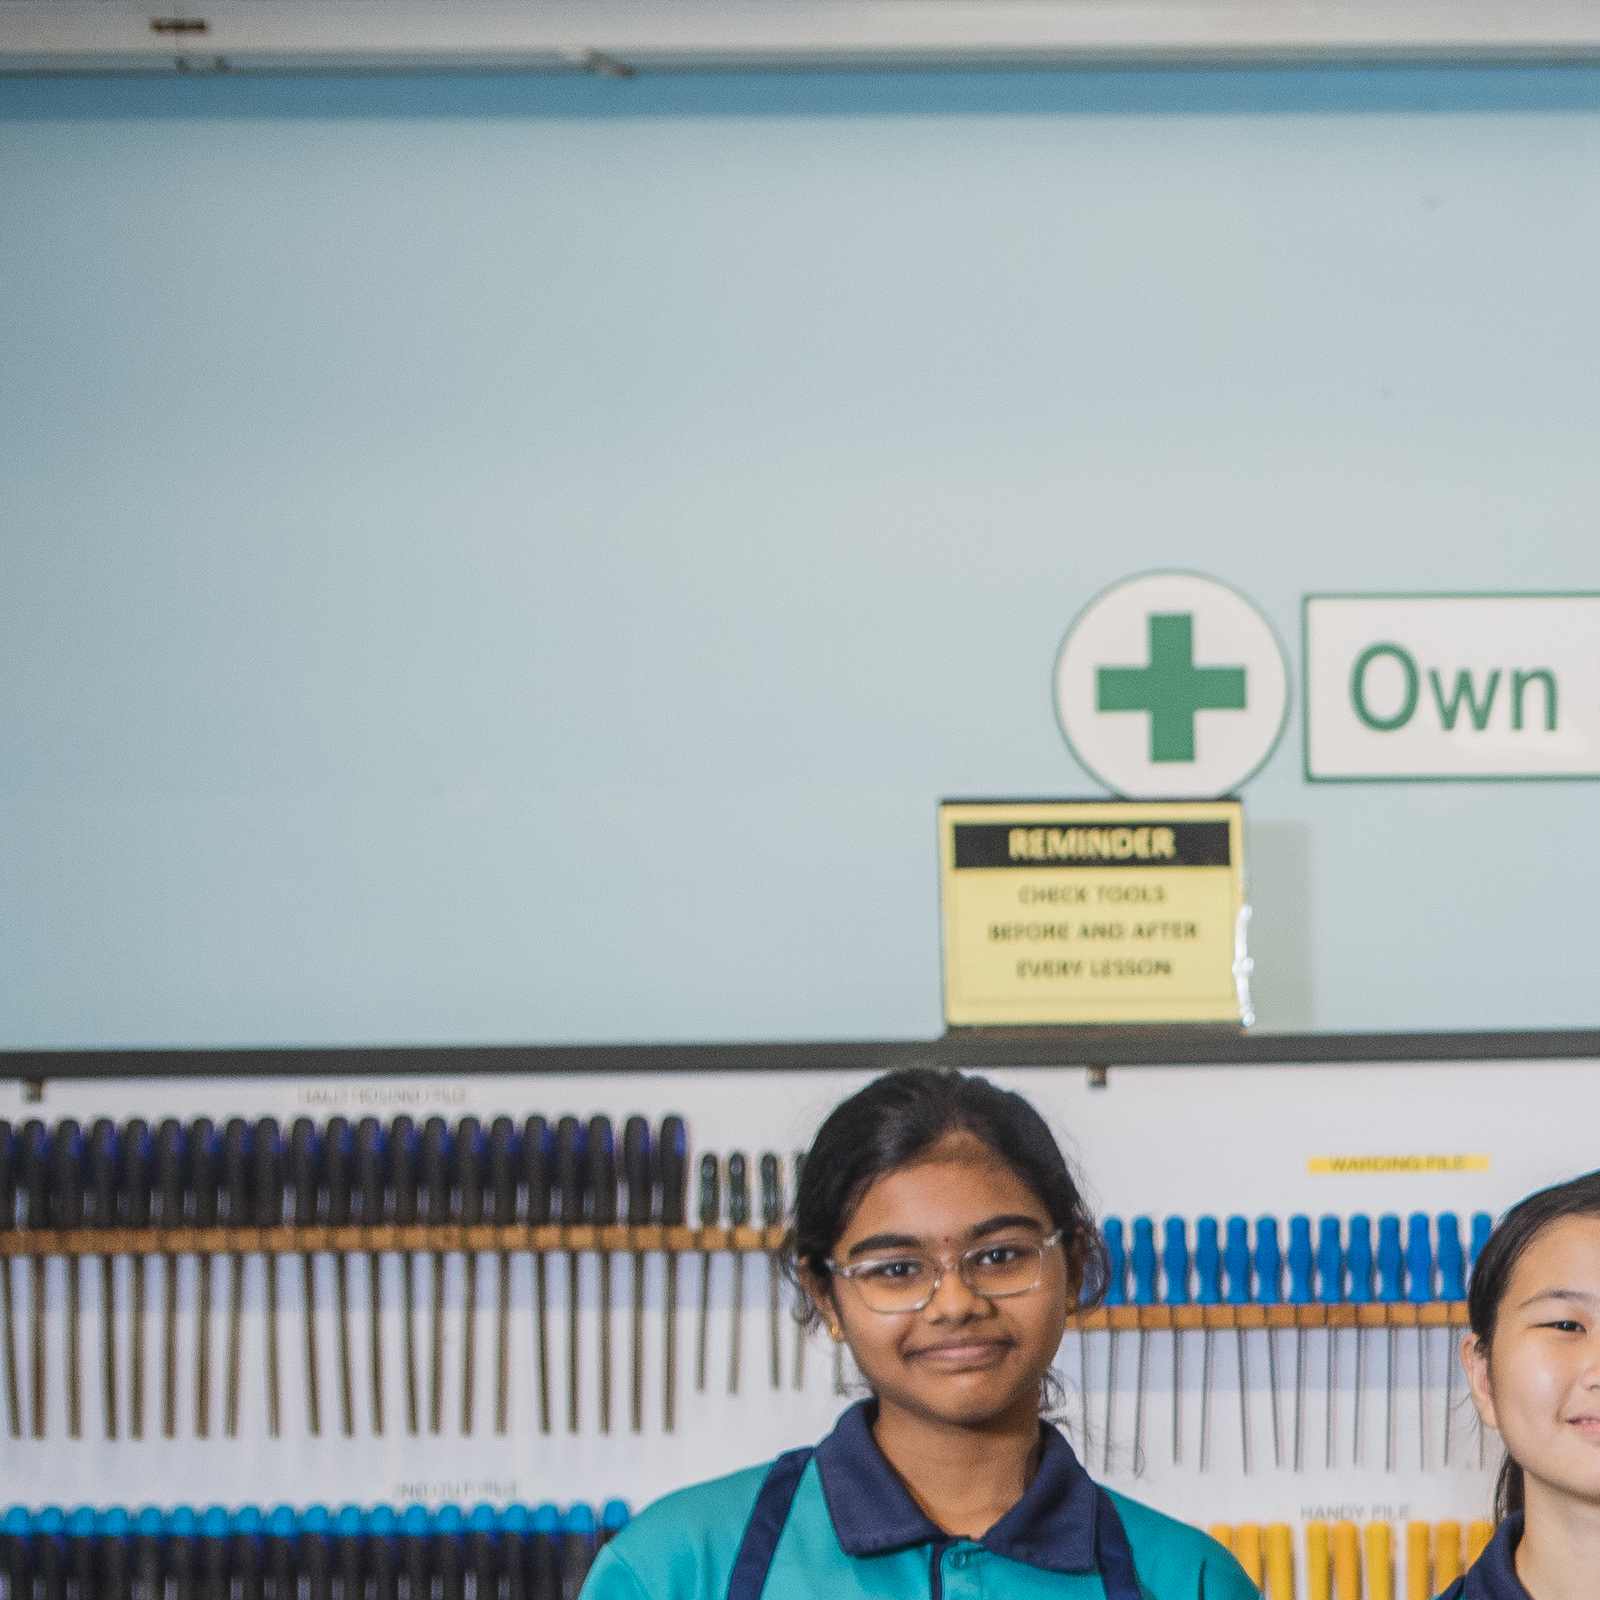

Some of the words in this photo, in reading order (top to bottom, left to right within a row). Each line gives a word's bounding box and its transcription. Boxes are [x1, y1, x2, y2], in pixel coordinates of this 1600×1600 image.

[1350, 642, 1558, 732] Own
[1008, 827, 1176, 860] REMINDER
[1018, 885, 1089, 905] CHECK
[1096, 884, 1166, 904] TOOLS
[987, 923, 1070, 942] BEFORE
[1078, 923, 1124, 941] AND
[1132, 921, 1198, 940] AFTER
[1016, 958, 1083, 979] EVERY
[1089, 958, 1173, 978] LESSON
[1300, 1503, 1364, 1520] HANDY
[1371, 1503, 1410, 1519] FILE
